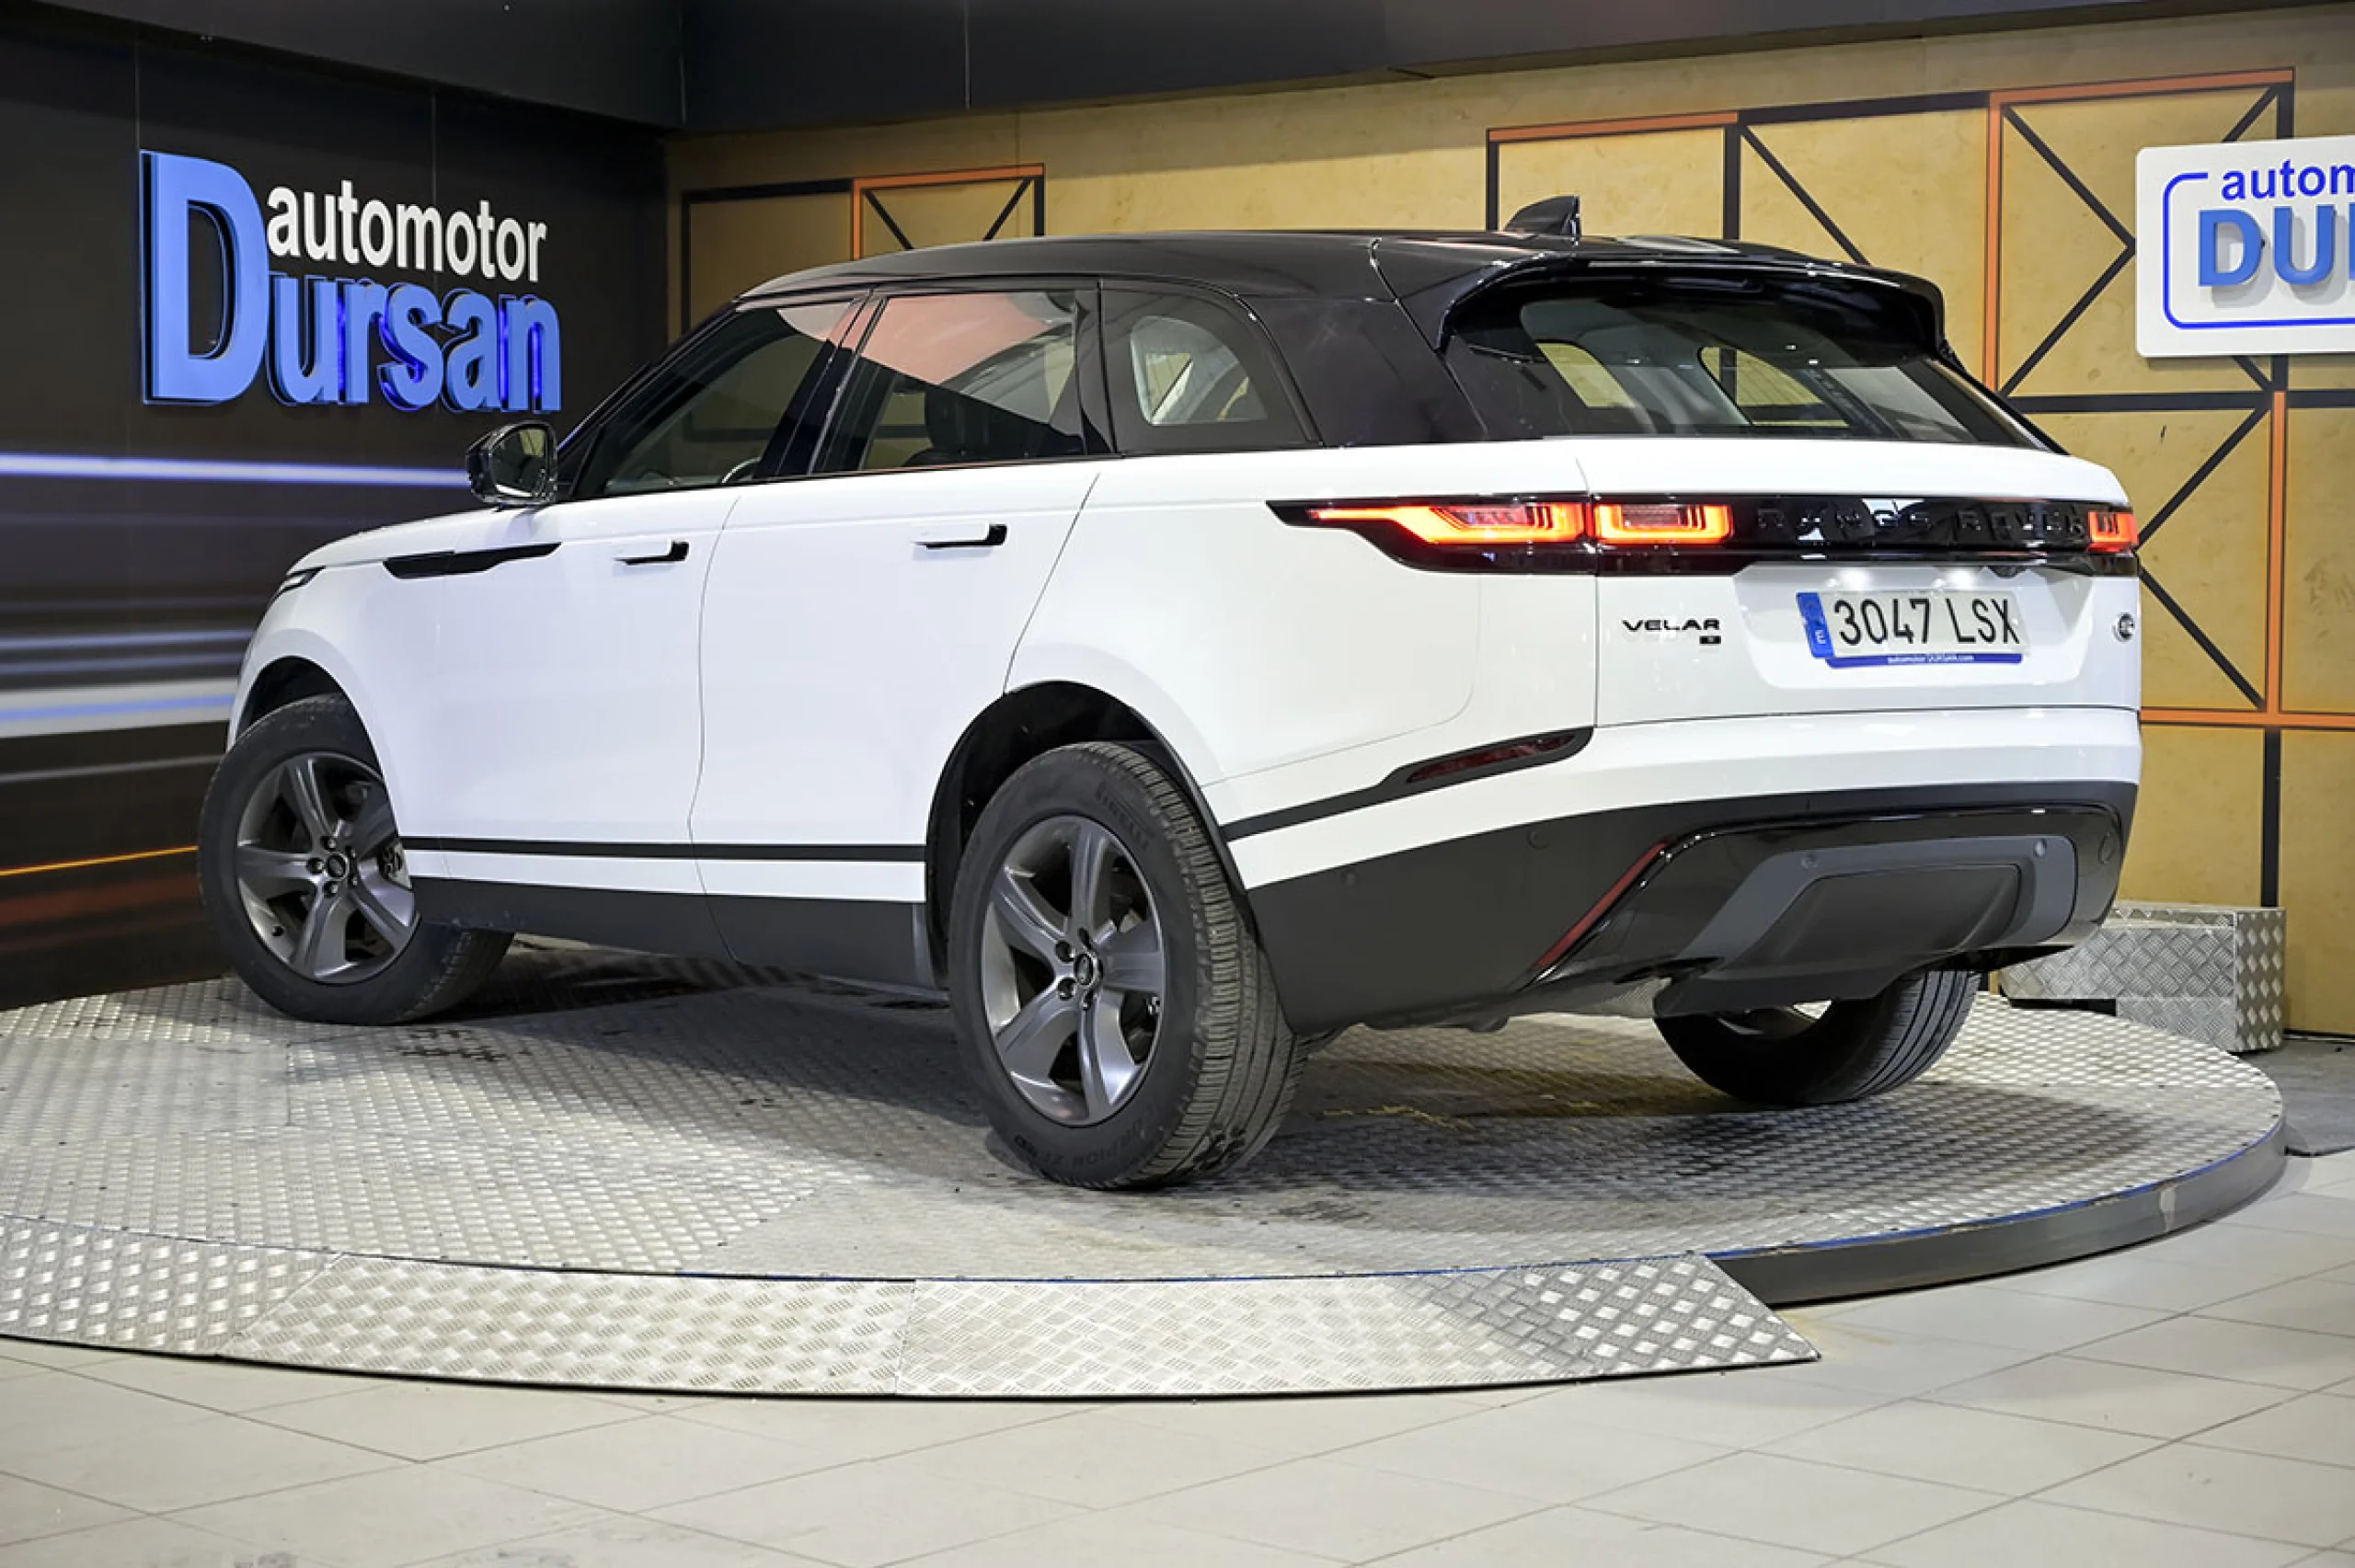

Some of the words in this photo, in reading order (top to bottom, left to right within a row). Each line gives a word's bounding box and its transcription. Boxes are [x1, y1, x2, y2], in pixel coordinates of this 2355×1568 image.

[267, 180, 547, 282] automotor
[2199, 202, 2355, 287] DU
[140, 150, 561, 413] Dursan
[1622, 619, 1720, 631] VELAR
[1834, 598, 1930, 646] 3047
[1946, 598, 2020, 645] LSX
